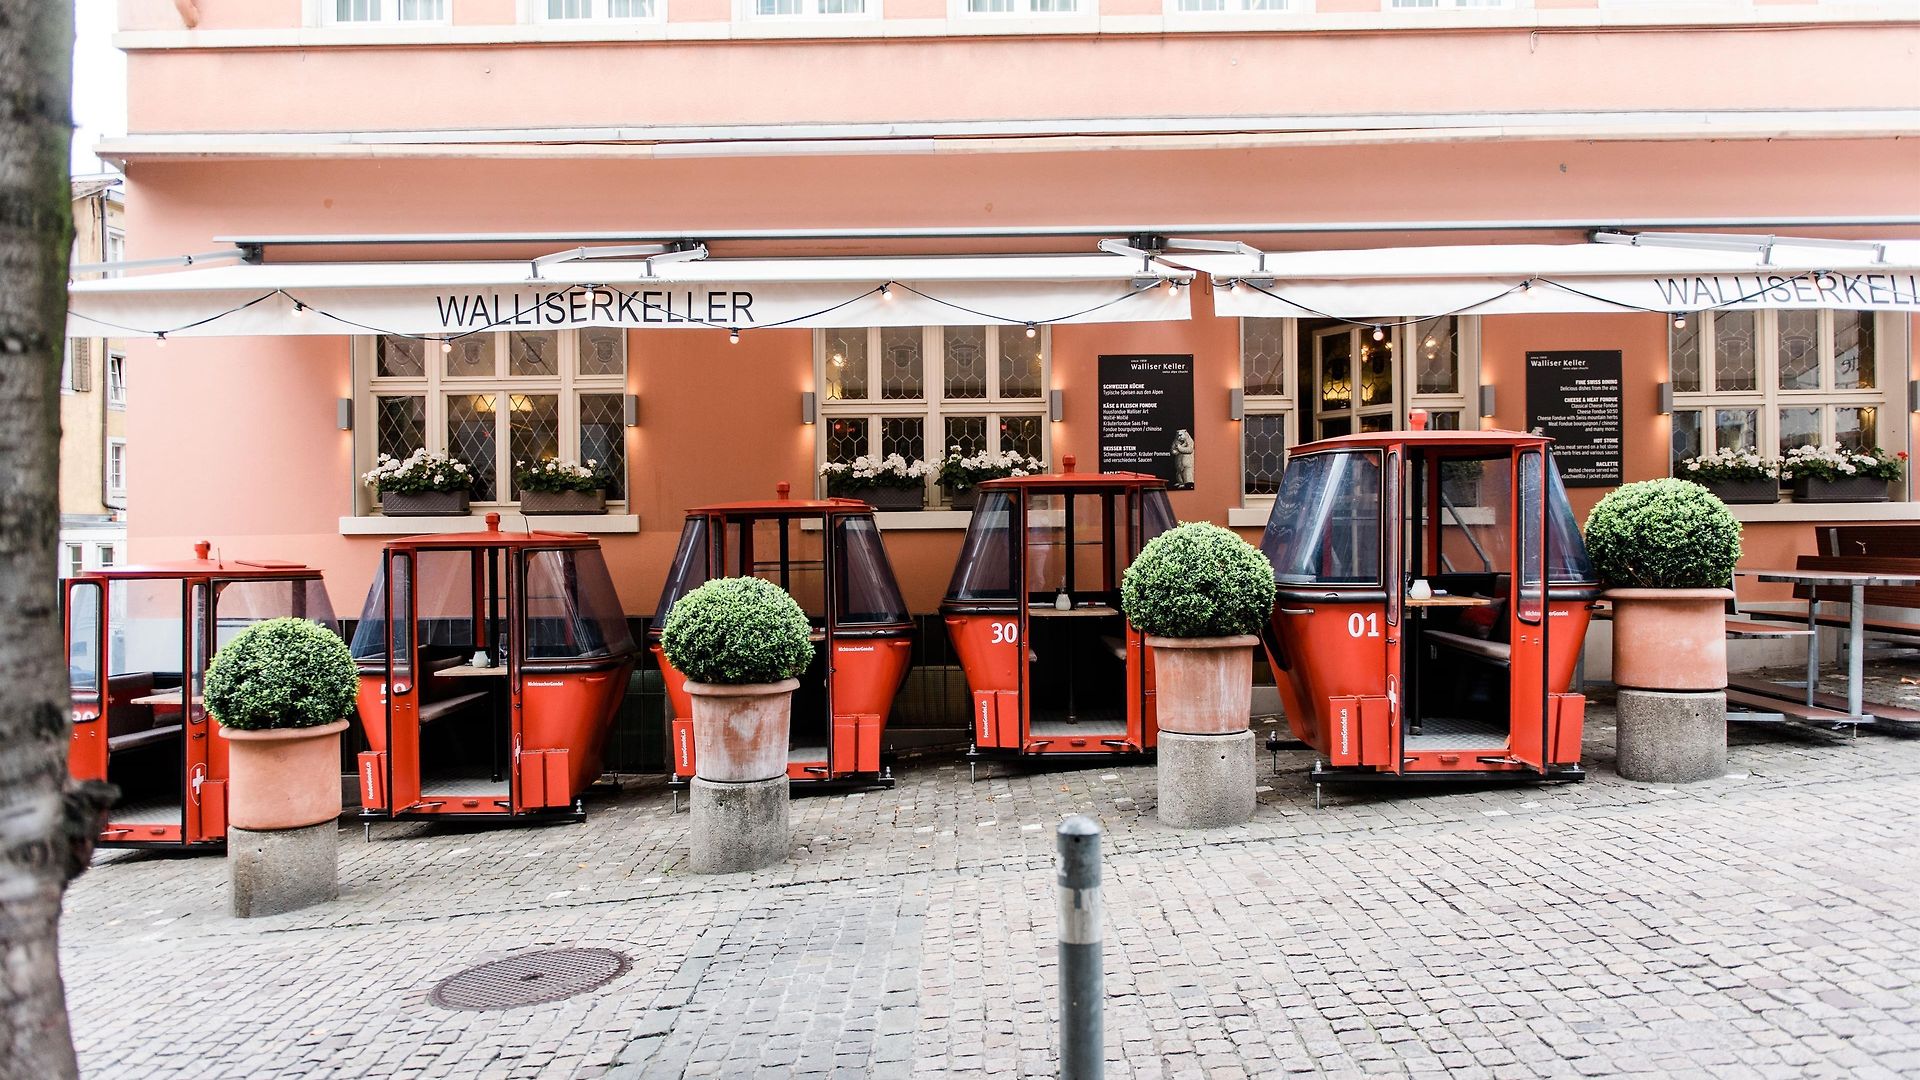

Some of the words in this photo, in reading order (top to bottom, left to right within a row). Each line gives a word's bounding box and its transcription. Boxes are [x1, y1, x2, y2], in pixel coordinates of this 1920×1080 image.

[436, 291, 755, 326] WALLISERKELLER
[991, 622, 1018, 644] 30
[1348, 612, 1379, 638] 01
